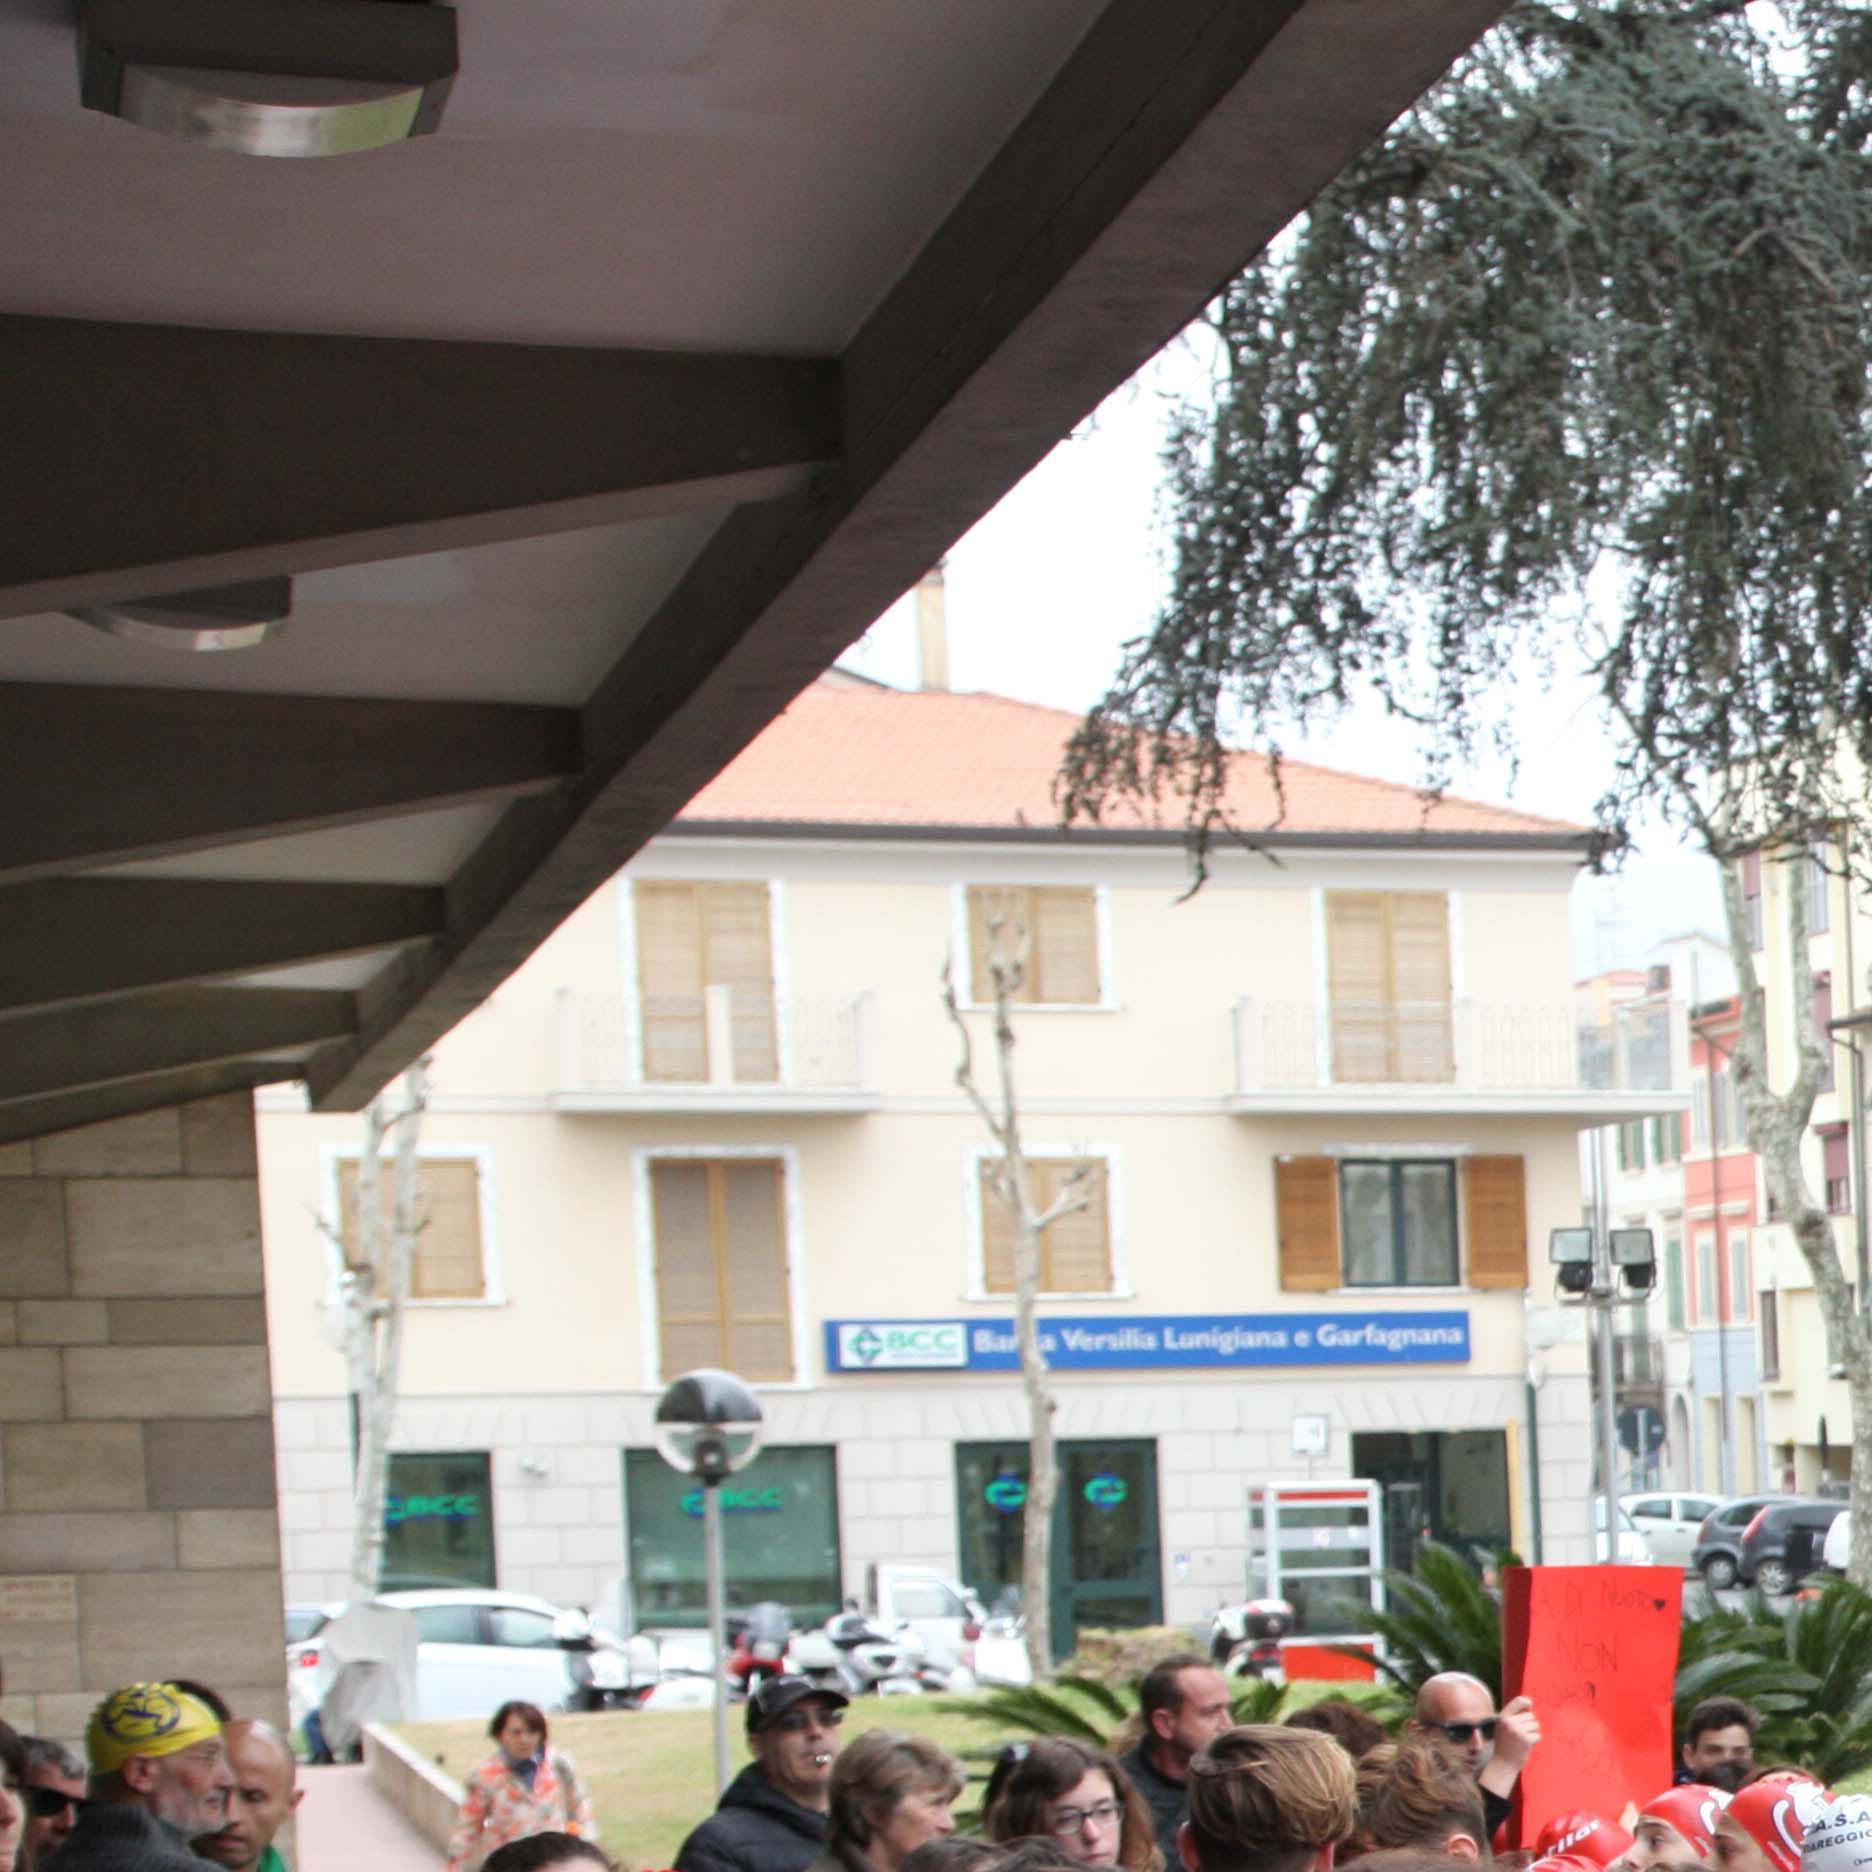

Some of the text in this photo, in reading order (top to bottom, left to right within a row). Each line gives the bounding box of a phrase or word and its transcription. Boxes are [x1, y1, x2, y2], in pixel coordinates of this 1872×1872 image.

[886, 1329, 958, 1350] BCC
[973, 1323, 1463, 1354] Bana Versilia Lunigiana e Garfagnana
